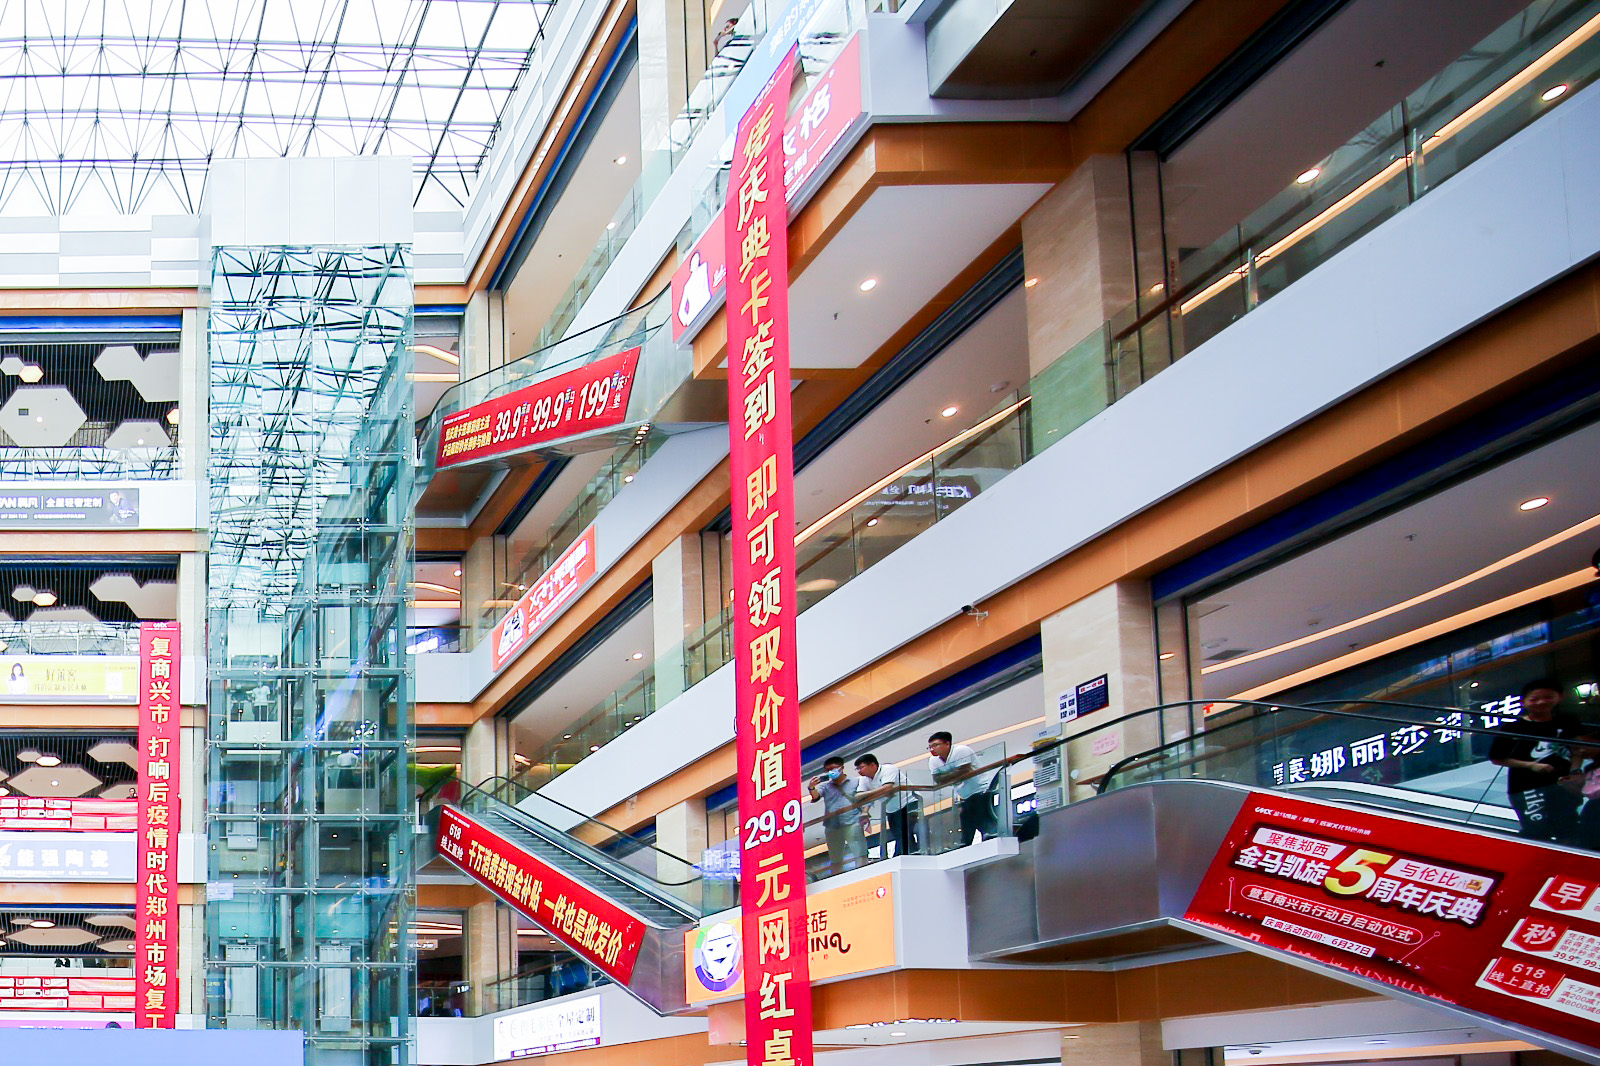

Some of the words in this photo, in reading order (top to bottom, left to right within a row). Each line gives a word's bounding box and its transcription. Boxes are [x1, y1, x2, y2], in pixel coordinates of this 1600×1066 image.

[737, 102, 776, 441] 凭庆典卡签到
[530, 391, 565, 433] 99.9
[577, 376, 611, 421] 199
[492, 405, 521, 443] 39.9
[148, 636, 172, 724] 复商兴市
[449, 824, 462, 839] 618
[1267, 833, 1331, 858] 聚焦郑西
[1234, 845, 1332, 887] 金马凯旋
[1324, 848, 1394, 895] 5
[1366, 877, 1485, 926] 周年庆典
[1400, 862, 1461, 887] 与伦比
[1550, 882, 1587, 904] 早
[468, 840, 543, 913] 千万消费券现金补贴
[544, 893, 623, 968] 一件也是批发价
[1247, 887, 1415, 943] 暨复商兴市行动月启动仪式
[1522, 923, 1557, 945] 秒
[1488, 970, 1551, 996] 线上直抢
[1511, 962, 1547, 979] 618
